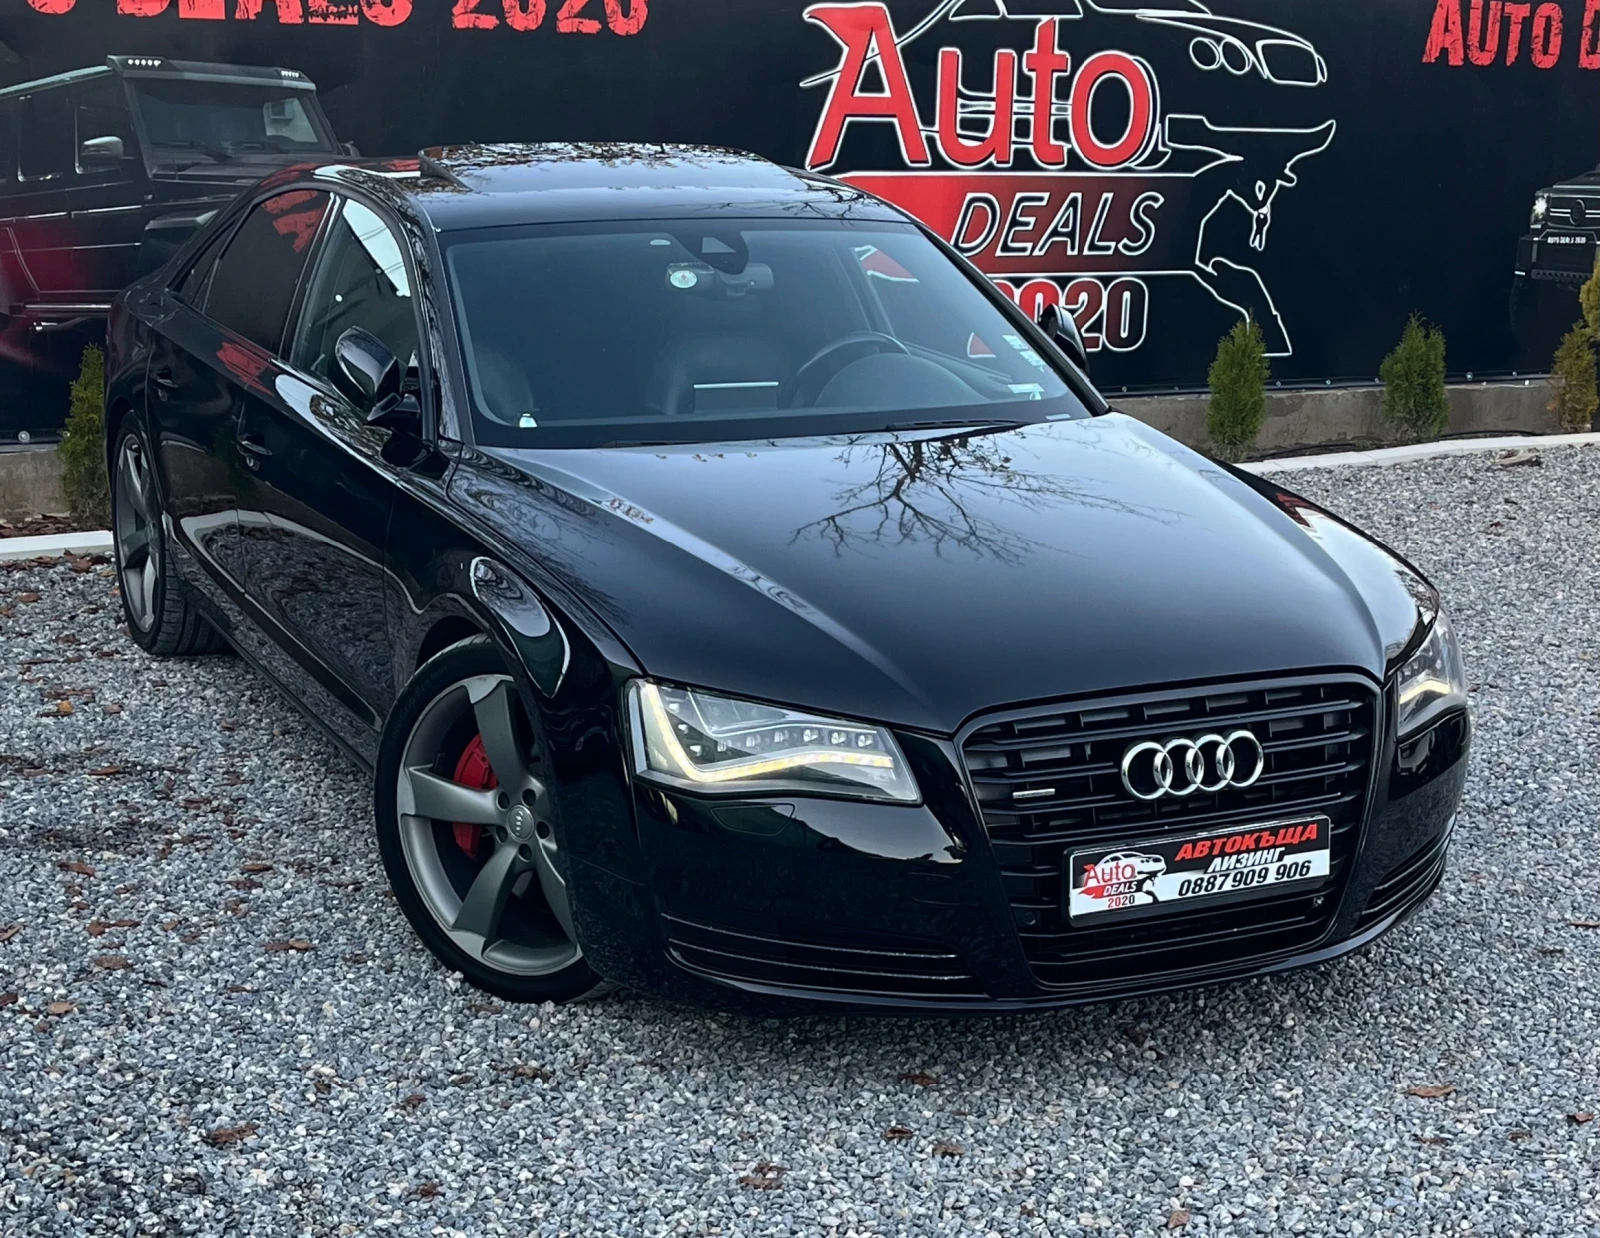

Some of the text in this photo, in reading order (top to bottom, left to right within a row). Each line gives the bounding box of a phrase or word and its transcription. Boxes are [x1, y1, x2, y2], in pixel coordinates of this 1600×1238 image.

[1422, 0, 1563, 69] AUTO
[803, 2, 1152, 170] Auto
[952, 191, 1164, 257] DEALS
[993, 276, 1149, 352] 20
[1173, 823, 1318, 862] АВТОКЪЩА
[1206, 846, 1286, 874] ЛИЗИНГ
[1082, 861, 1136, 888] Auto
[1103, 881, 1138, 896] DEALS
[1178, 860, 1312, 897] 0887 909 906
[1107, 894, 1136, 909] 2020
